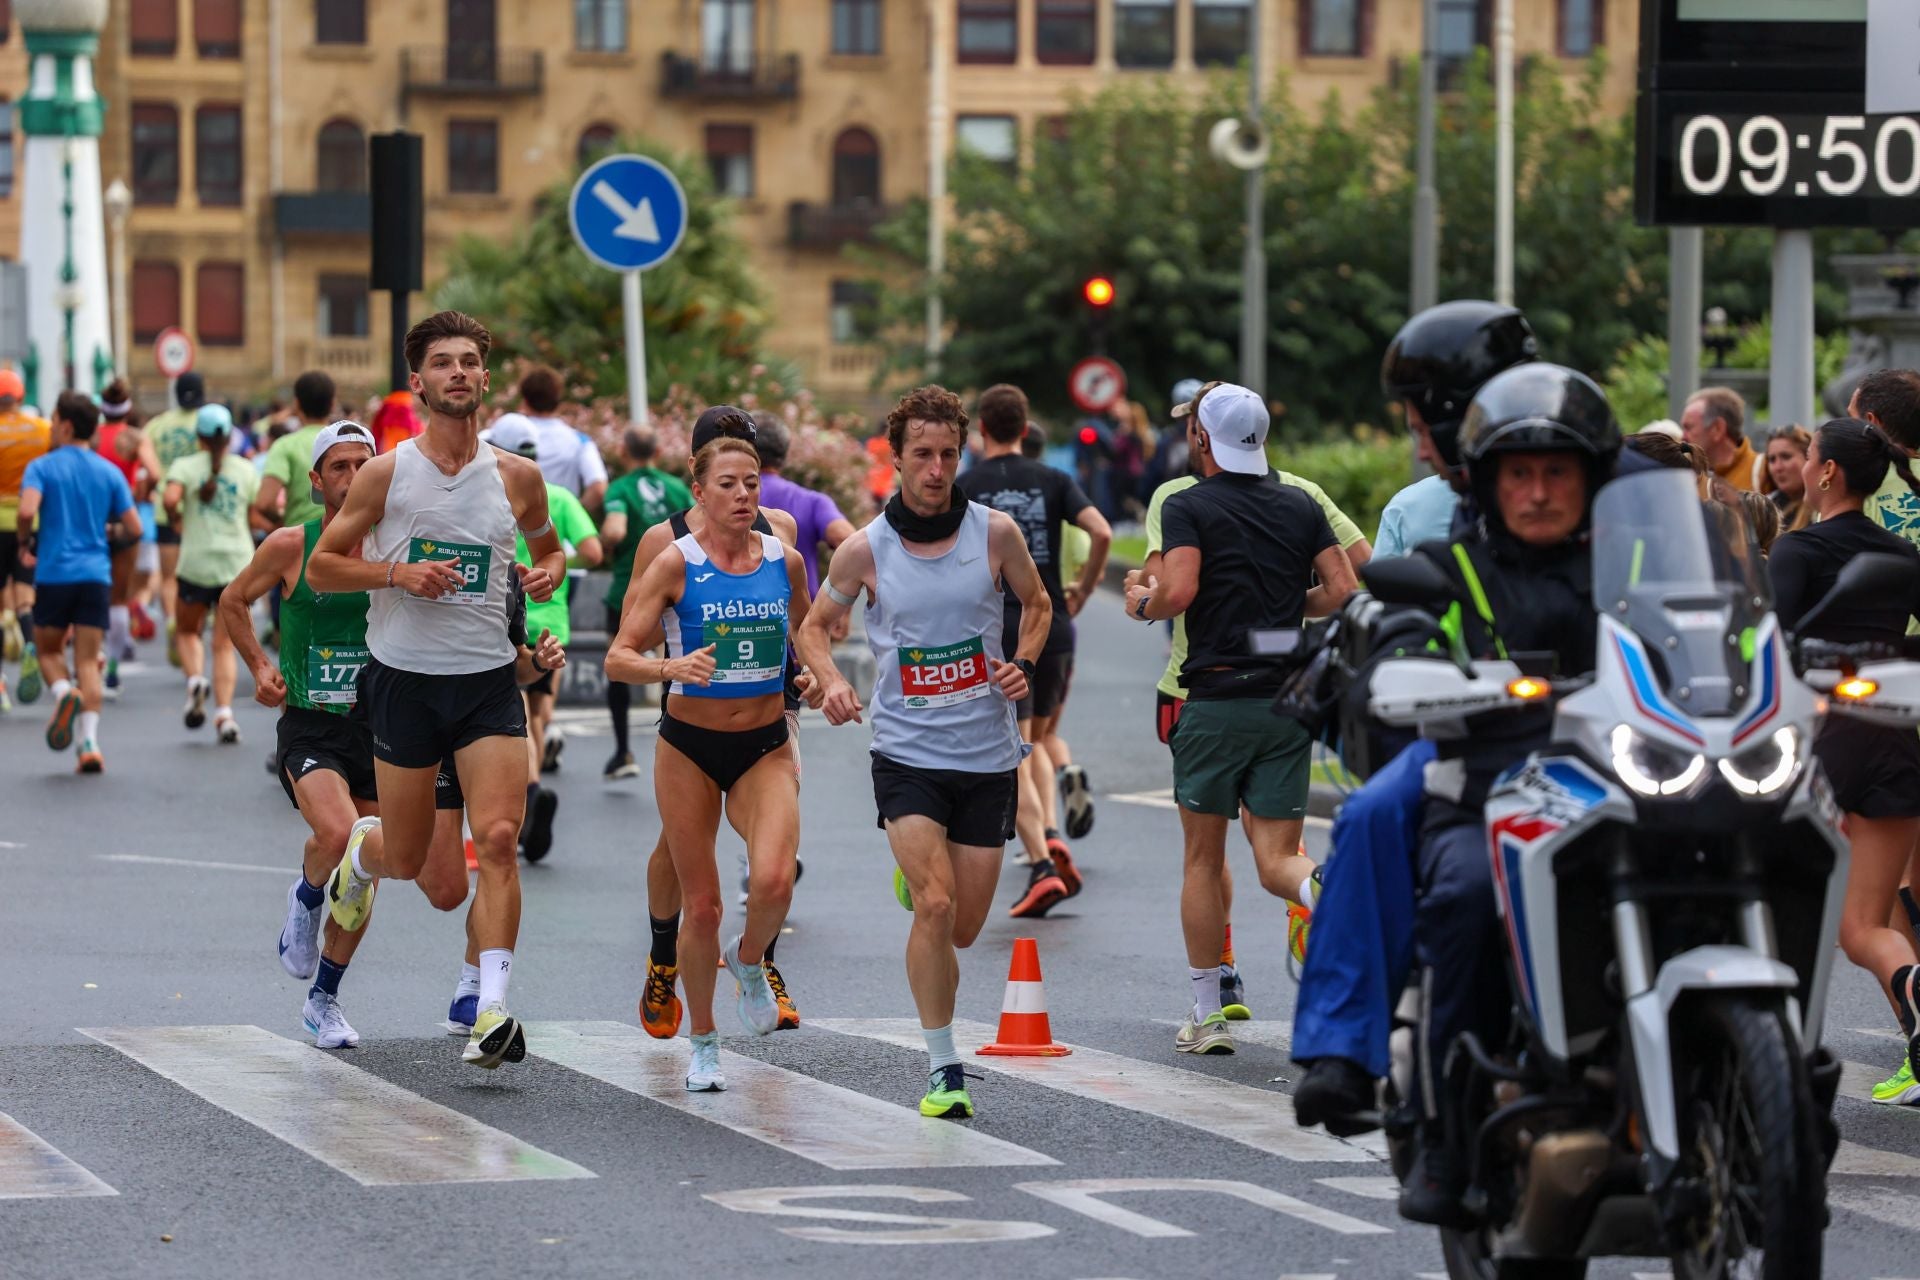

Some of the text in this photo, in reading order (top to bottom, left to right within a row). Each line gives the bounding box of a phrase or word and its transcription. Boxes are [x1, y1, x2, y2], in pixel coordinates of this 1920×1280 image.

[1680, 114, 1920, 196] 09:50
[437, 547, 482, 558] RURAL KUTXA
[755, 625, 777, 633] KUTXA
[738, 640, 754, 660] 9
[950, 645, 973, 657] KUTXA
[731, 661, 760, 669] PELAYO
[320, 663, 368, 683] 177
[910, 657, 976, 686] 1208
[341, 683, 356, 691] IBAI
[938, 684, 954, 693] JON
